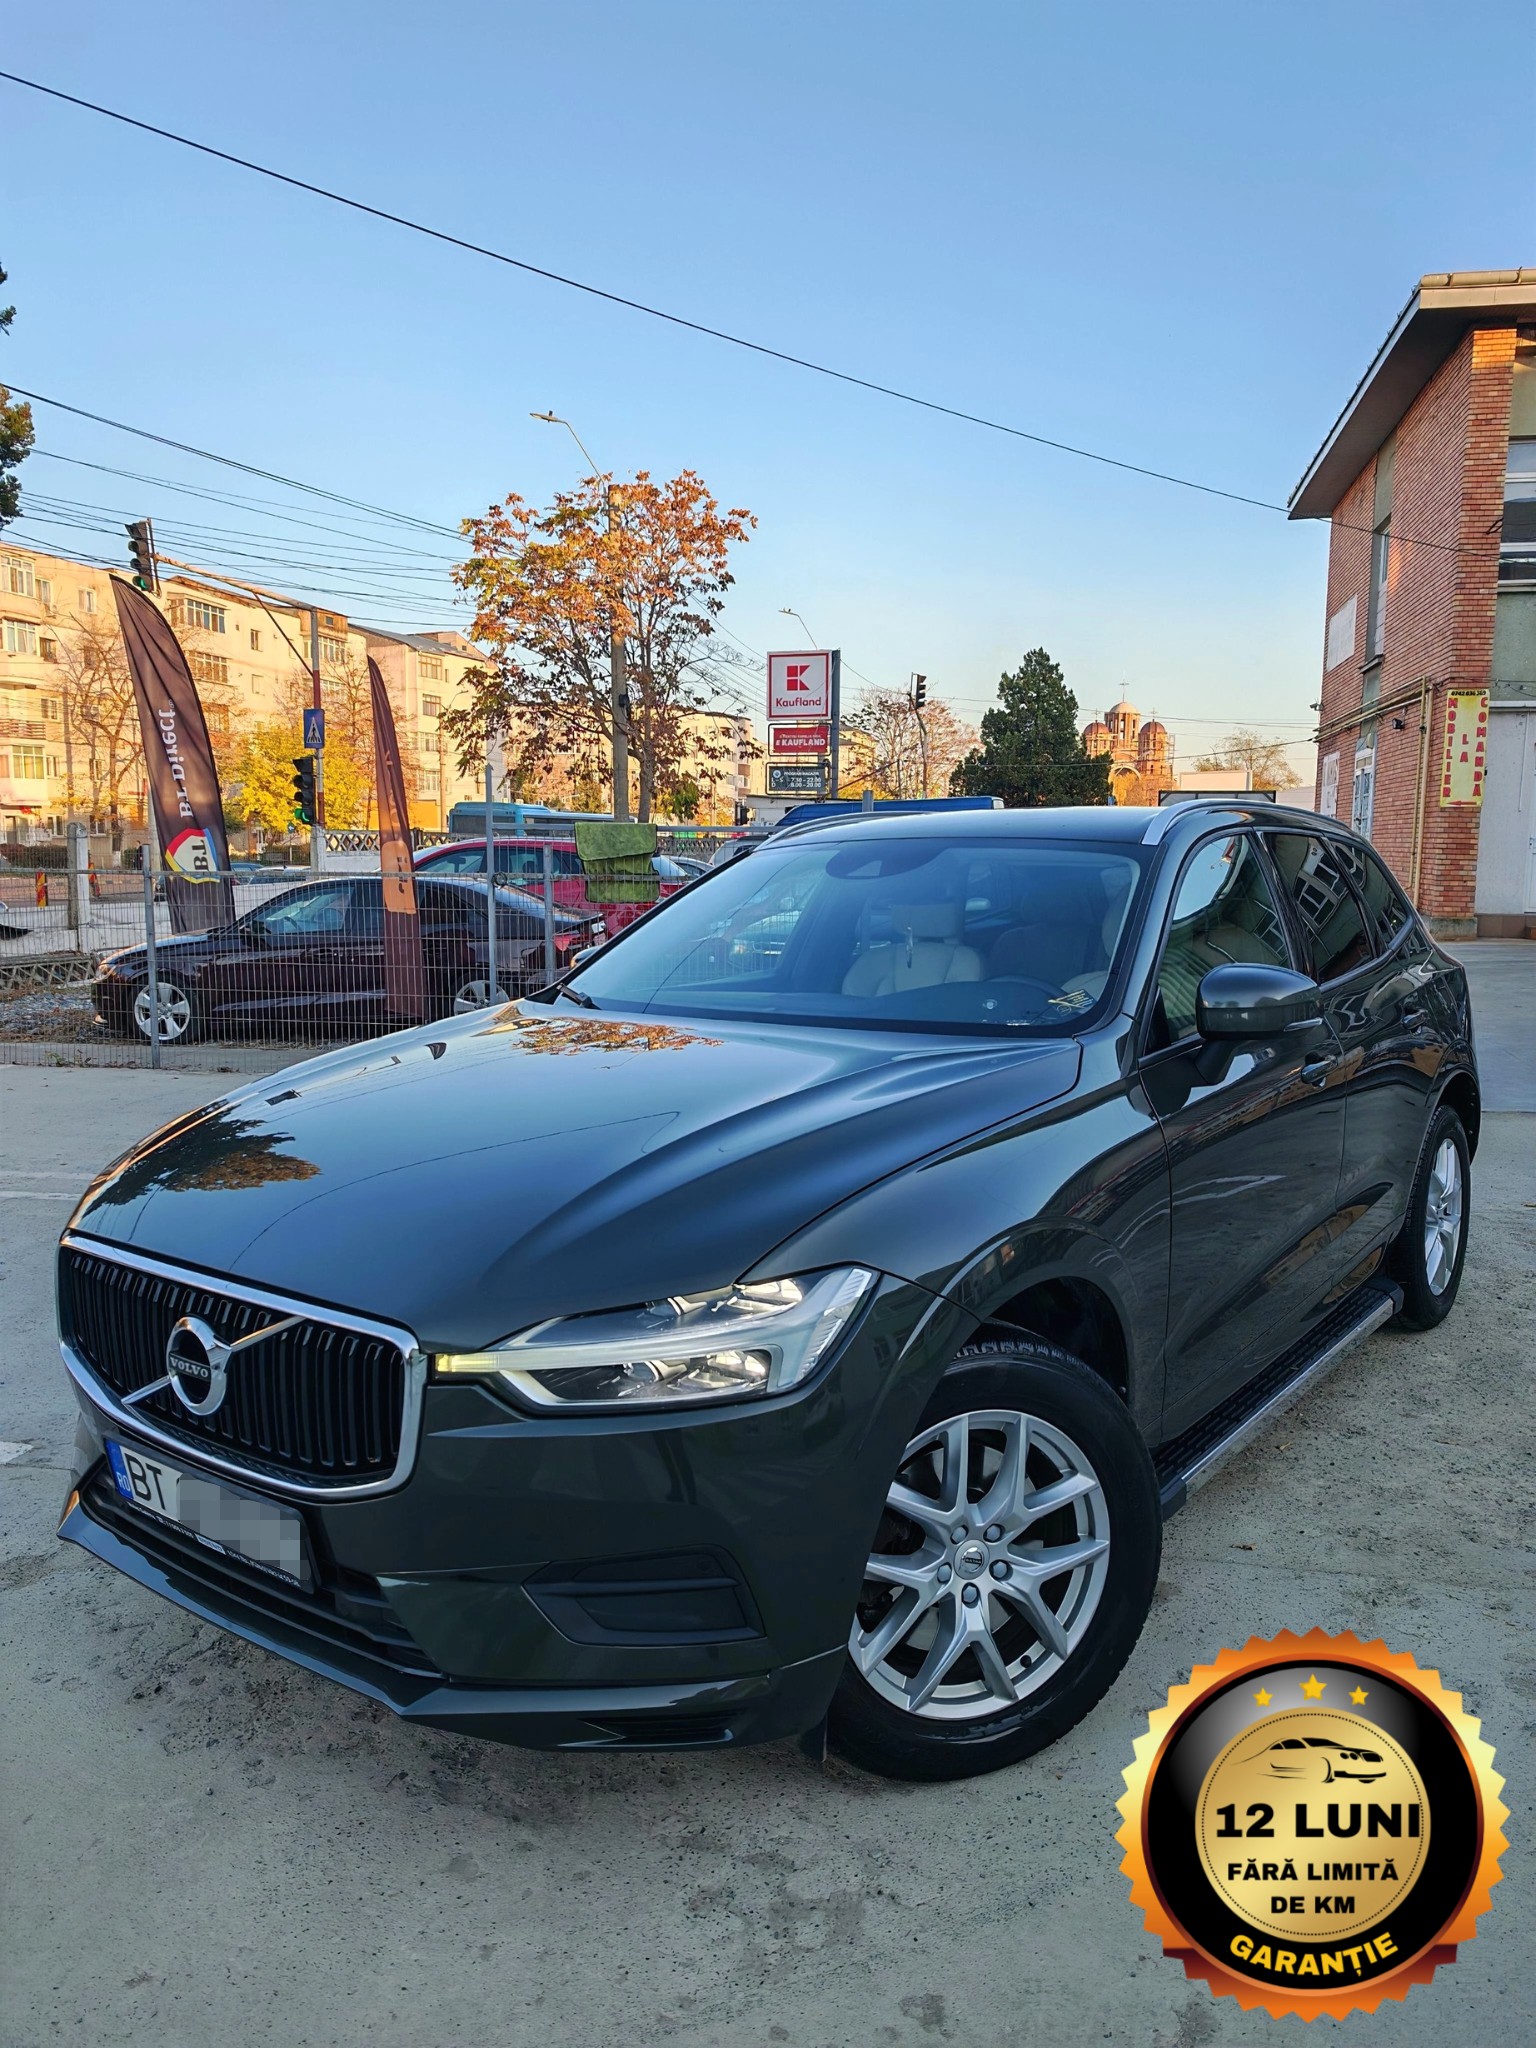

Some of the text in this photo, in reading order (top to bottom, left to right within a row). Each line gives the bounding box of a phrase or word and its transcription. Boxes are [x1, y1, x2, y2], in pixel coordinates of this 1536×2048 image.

[776, 697, 821, 707] Kaufland
[781, 738, 826, 746] KAUFLAND
[1442, 698, 1458, 797] MOBILIER
[1472, 697, 1488, 796] COMANDA
[170, 1357, 208, 1377] VOLVO
[116, 1471, 131, 1491] RO
[124, 1453, 165, 1510] BT
